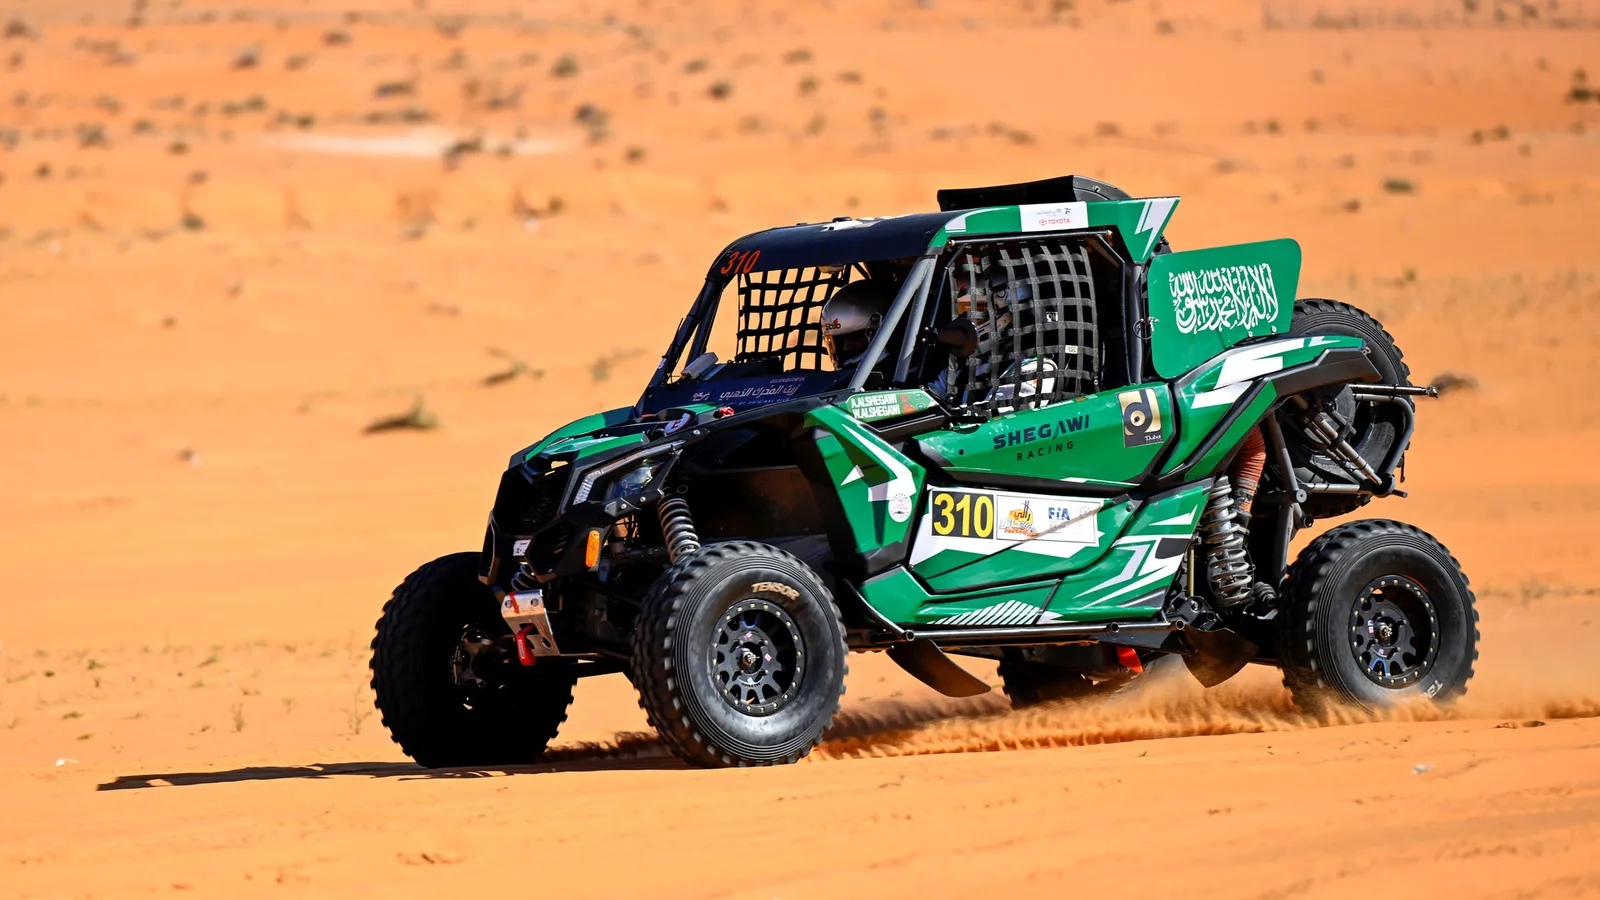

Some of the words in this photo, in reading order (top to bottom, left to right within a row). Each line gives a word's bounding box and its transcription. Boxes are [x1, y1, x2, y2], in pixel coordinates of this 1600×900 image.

[721, 250, 761, 275] 310
[993, 414, 1090, 450] SHEGAWI
[1016, 441, 1074, 462] RACING
[933, 493, 995, 537] 310
[751, 581, 800, 601] TENSOR
